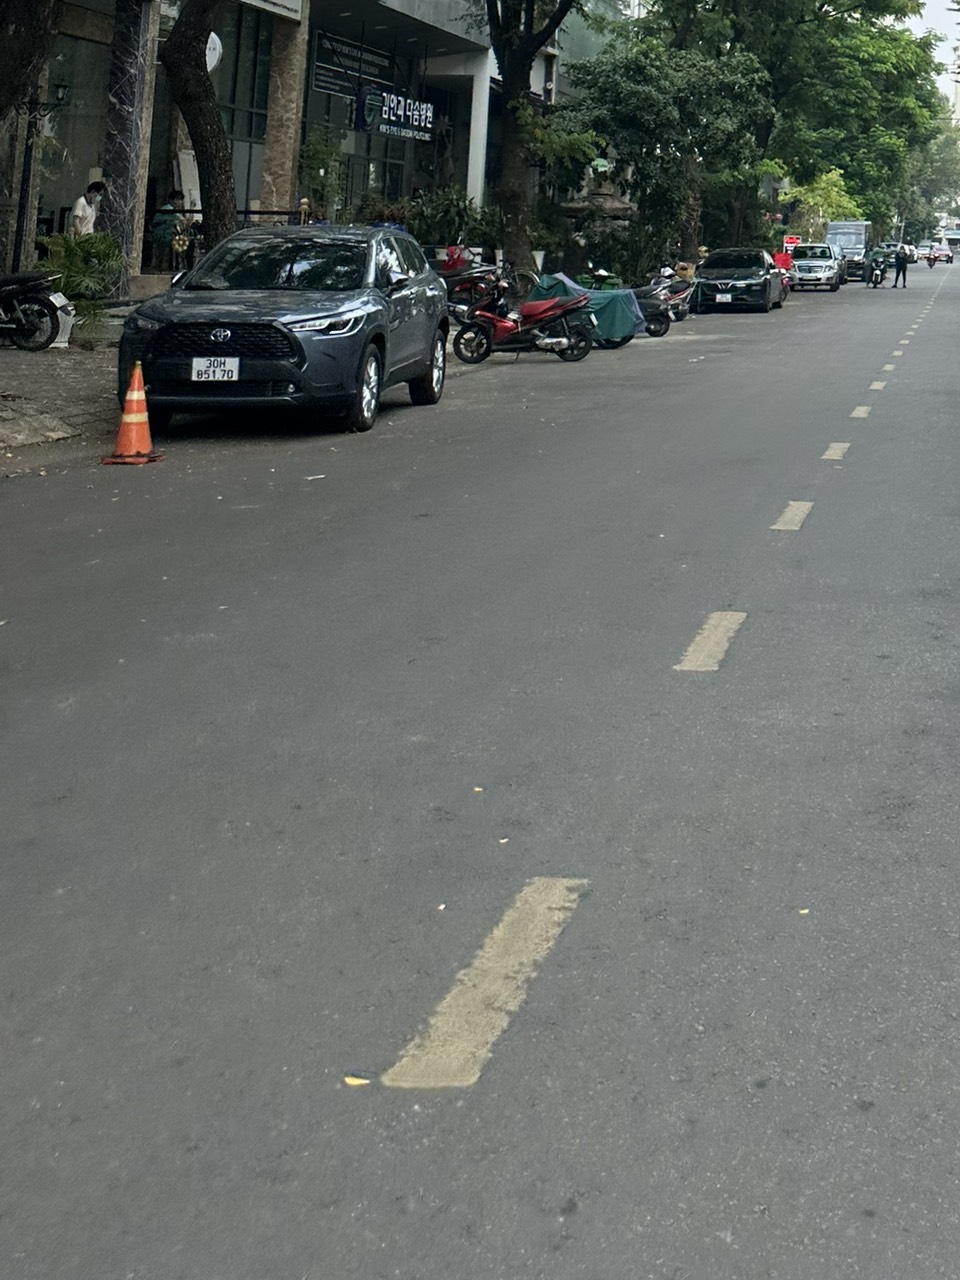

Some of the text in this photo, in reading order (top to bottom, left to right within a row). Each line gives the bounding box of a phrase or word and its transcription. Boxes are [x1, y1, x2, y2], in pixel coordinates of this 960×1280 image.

[382, 92, 434, 128] 김안과 다솜병원
[206, 358, 226, 369] 30H
[196, 369, 234, 380] 851.70
